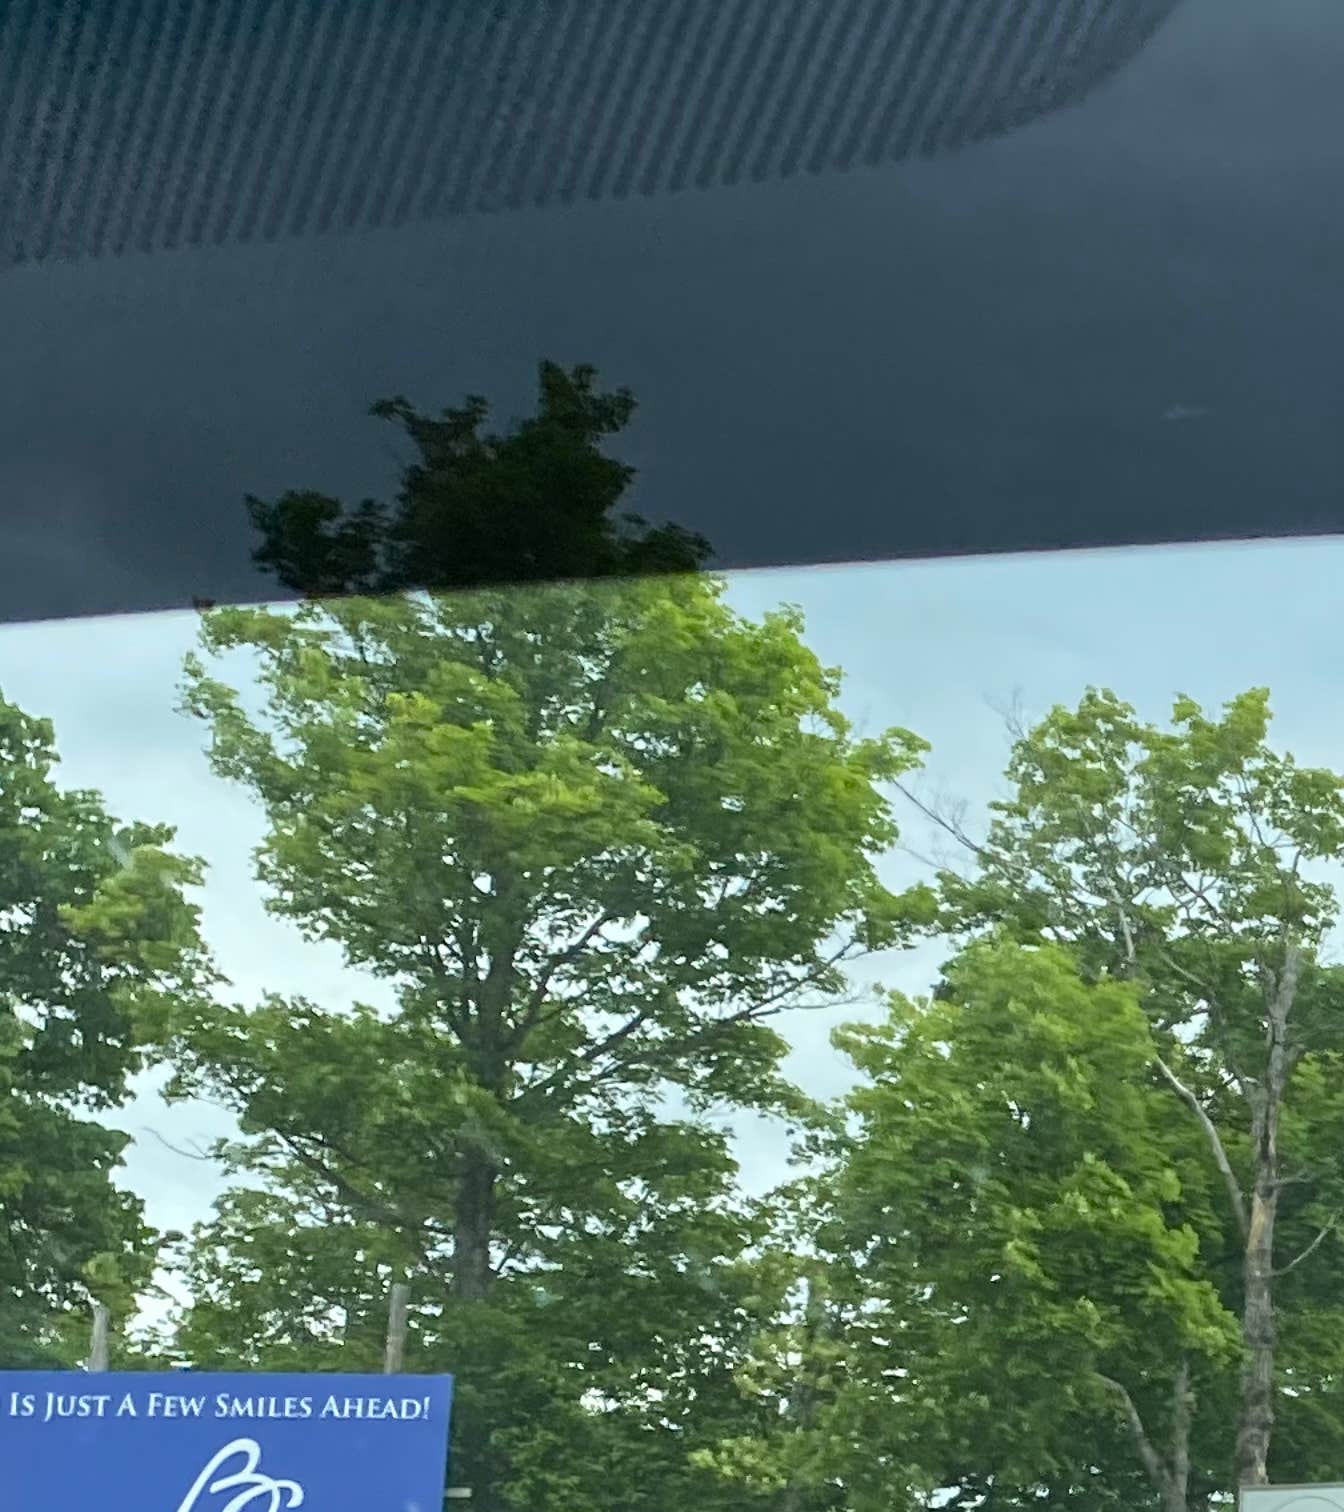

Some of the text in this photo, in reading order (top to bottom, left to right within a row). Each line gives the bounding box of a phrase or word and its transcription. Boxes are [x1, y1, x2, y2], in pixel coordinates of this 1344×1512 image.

[44, 1392, 111, 1422] JUST
[117, 1393, 137, 1417] A
[147, 1393, 206, 1418] FEW
[214, 1393, 312, 1418] SMILES
[320, 1395, 431, 1420] AHEAD!
